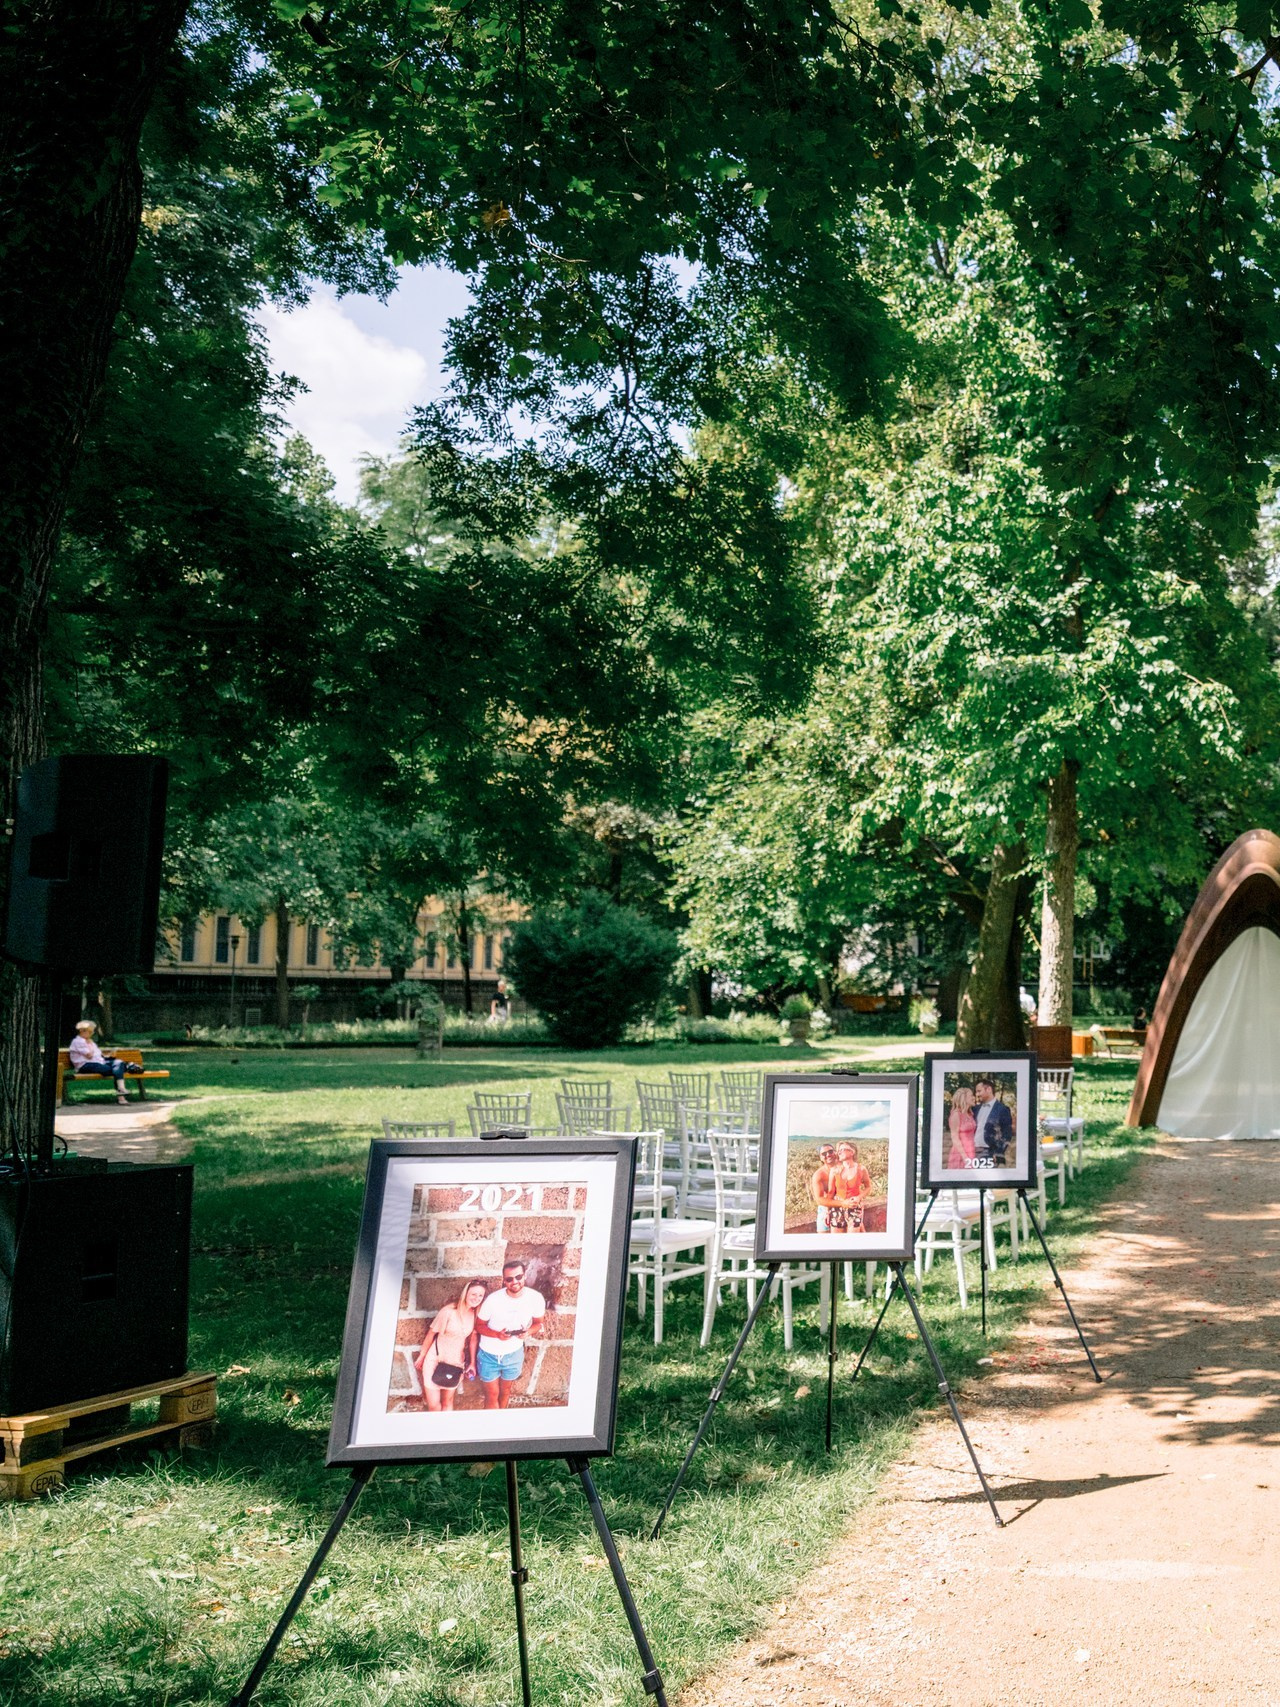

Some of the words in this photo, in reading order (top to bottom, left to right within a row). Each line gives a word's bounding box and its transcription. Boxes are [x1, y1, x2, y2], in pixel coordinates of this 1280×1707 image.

[822, 1105, 859, 1118] 2023
[964, 1158, 994, 1169] 2025
[459, 1184, 542, 1211] 2021
[36, 1475, 59, 1491] EPAL
